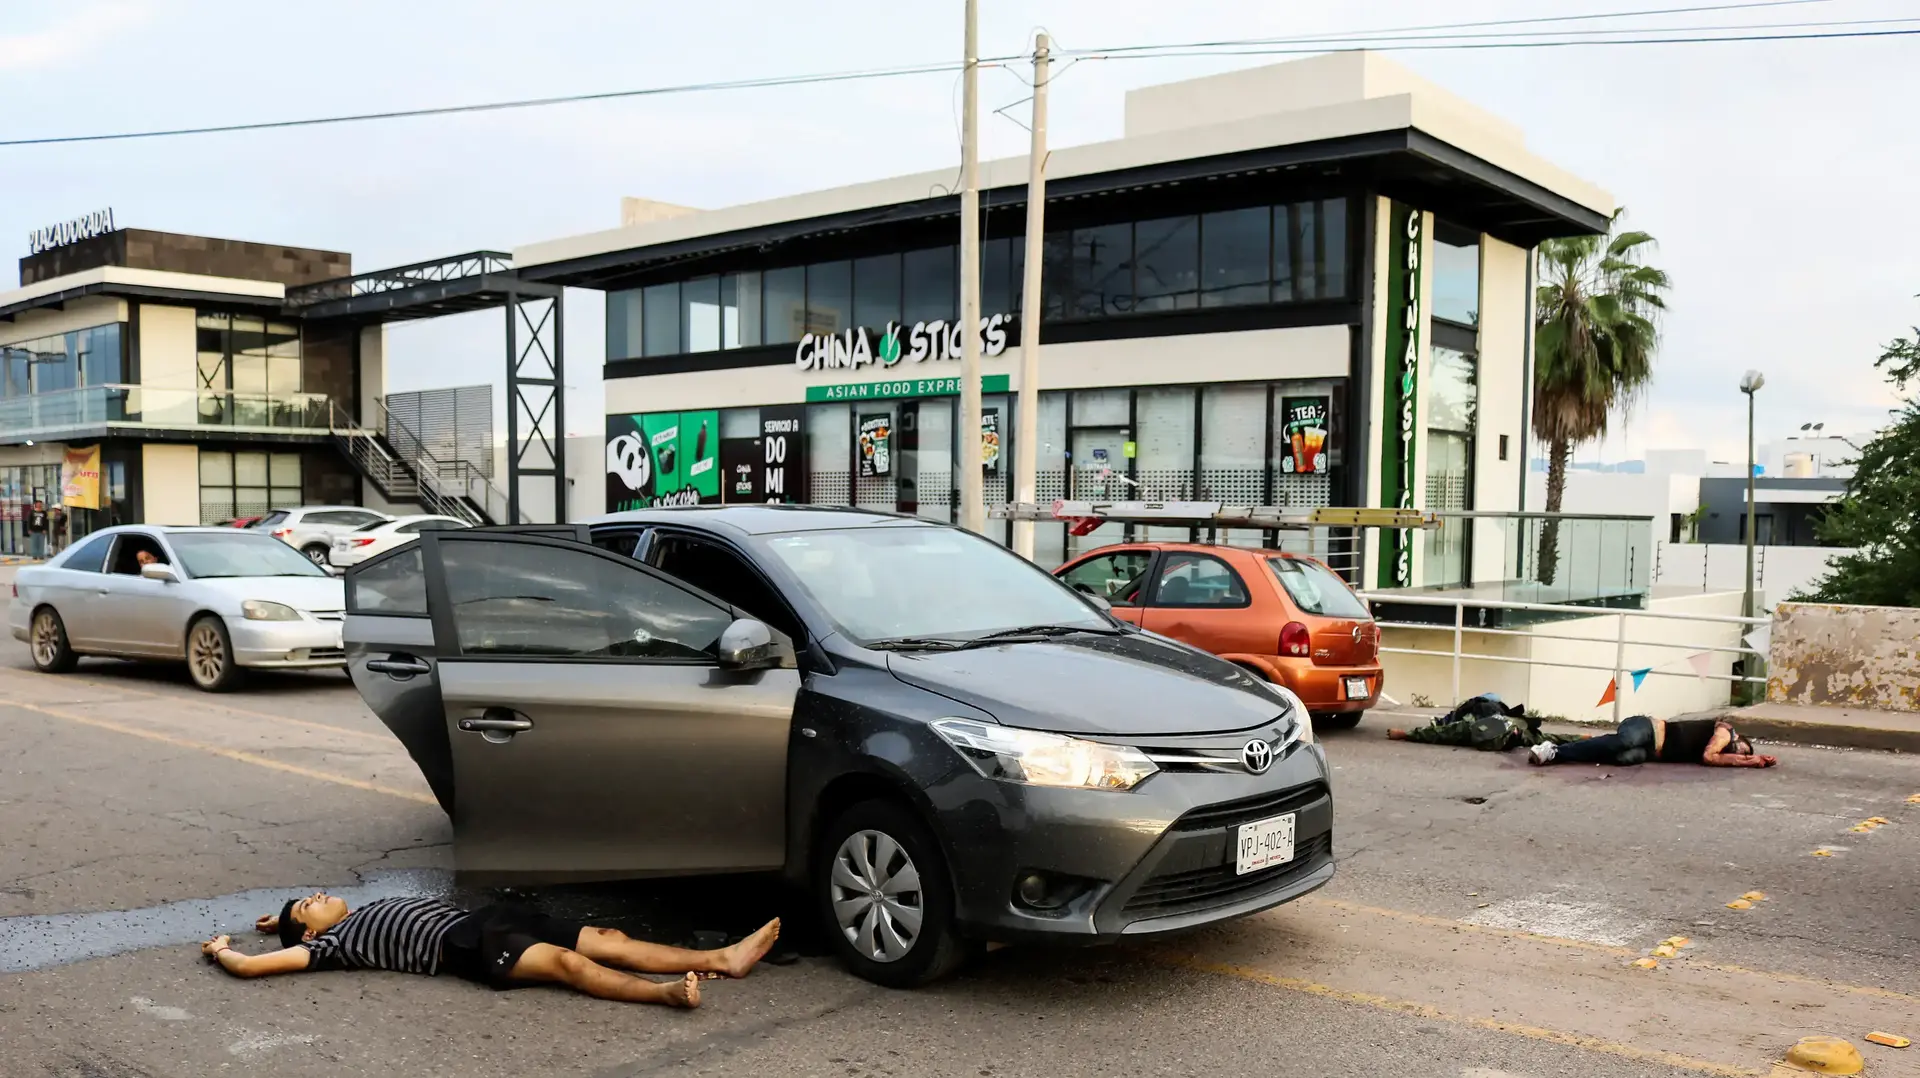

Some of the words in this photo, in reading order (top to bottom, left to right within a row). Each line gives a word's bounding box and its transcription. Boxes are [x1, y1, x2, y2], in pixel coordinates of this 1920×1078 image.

[1404, 210, 1418, 364] CHINA
[796, 325, 873, 370] CHINA
[826, 385, 867, 399] ASIAN
[874, 381, 911, 395] FOOD
[918, 377, 984, 394] EXPRE
[764, 420, 791, 433] SERVICIO
[792, 419, 799, 432] A
[1295, 405, 1316, 420] TEA
[765, 435, 786, 464] DO
[765, 467, 784, 494] MI
[1241, 826, 1293, 860] VPJ-402-A
